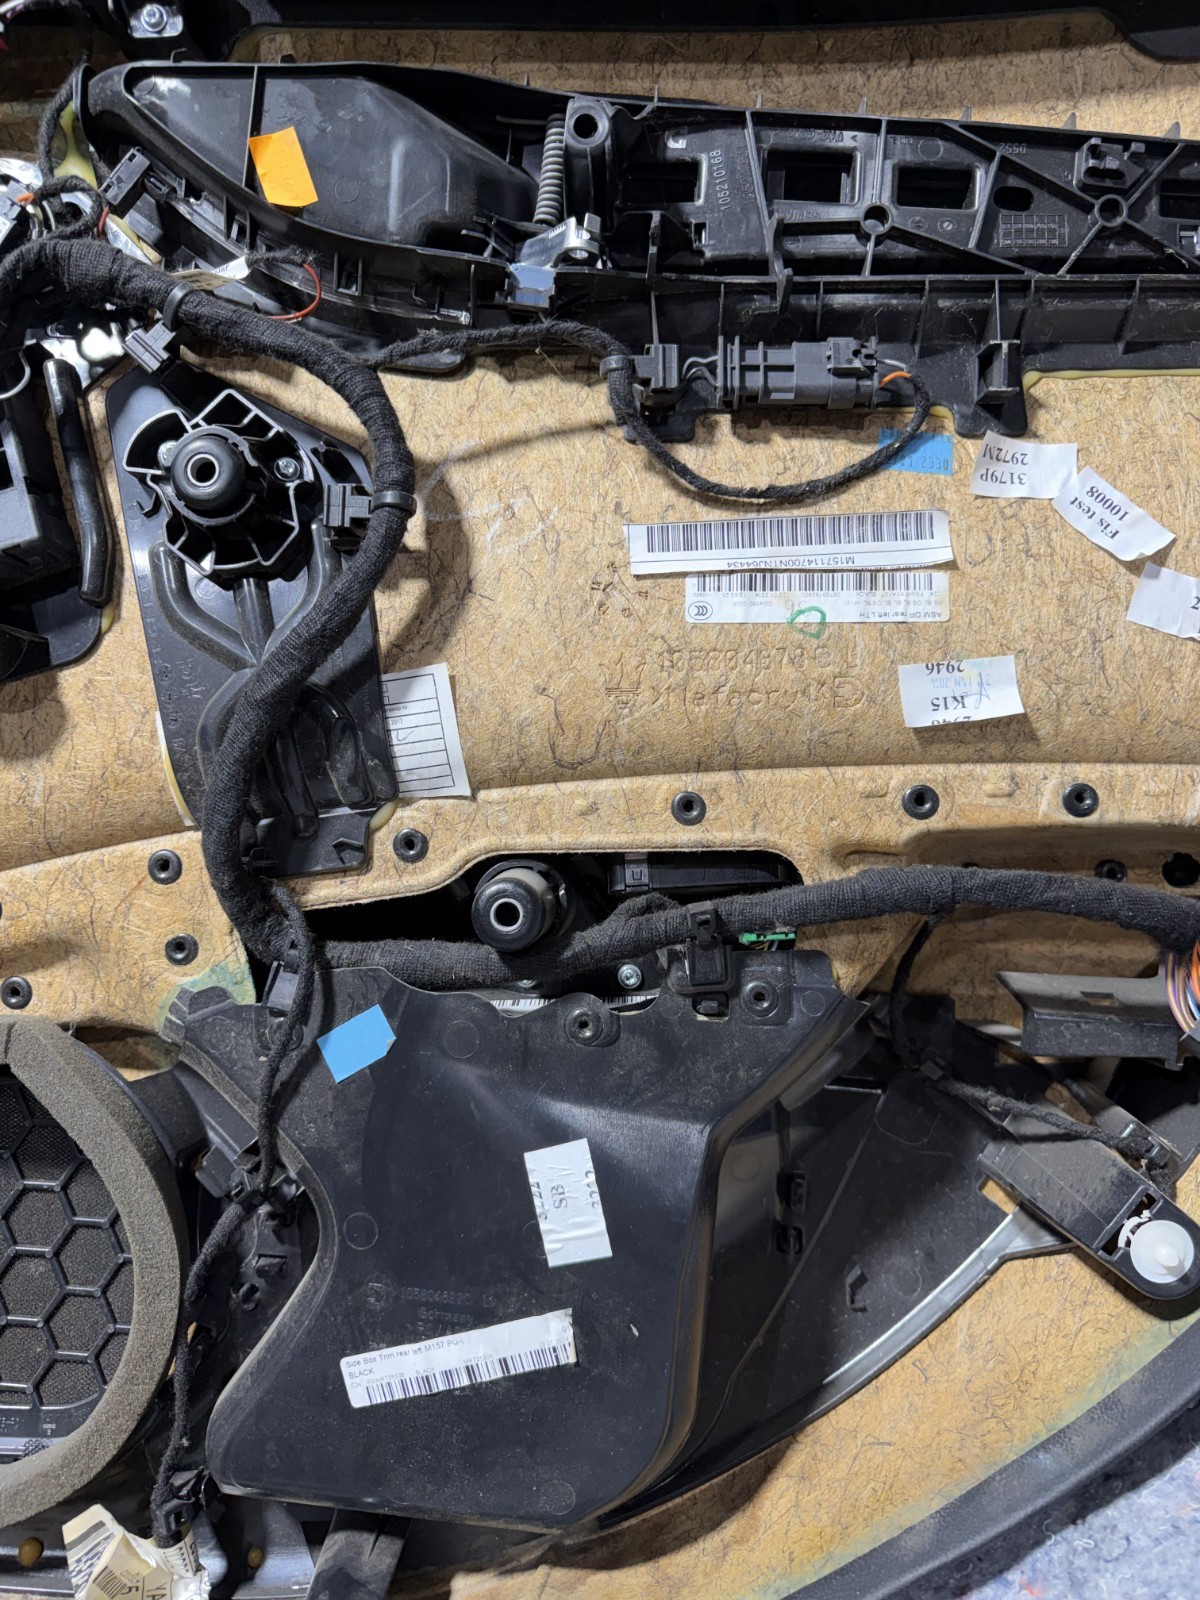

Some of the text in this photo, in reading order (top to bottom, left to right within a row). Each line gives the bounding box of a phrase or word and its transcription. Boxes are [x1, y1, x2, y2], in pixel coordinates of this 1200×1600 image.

[709, 149, 732, 210] 105210168
[982, 443, 1029, 466] 2972M
[980, 467, 1027, 486] 3179P
[1086, 485, 1130, 522] 10008
[1069, 496, 1120, 540] Fis test
[860, 611, 876, 619] LTH
[892, 611, 907, 619] rear
[921, 611, 943, 619] ASM
[925, 660, 966, 676] 2946
[930, 695, 967, 712] K15
[551, 1183, 568, 1209] SB
[345, 1360, 362, 1369] Side
[363, 1356, 377, 1365] Box
[379, 1353, 395, 1361] Trim
[412, 1347, 423, 1355] left
[424, 1341, 445, 1353] M157
[348, 1367, 375, 1380] BLACK
